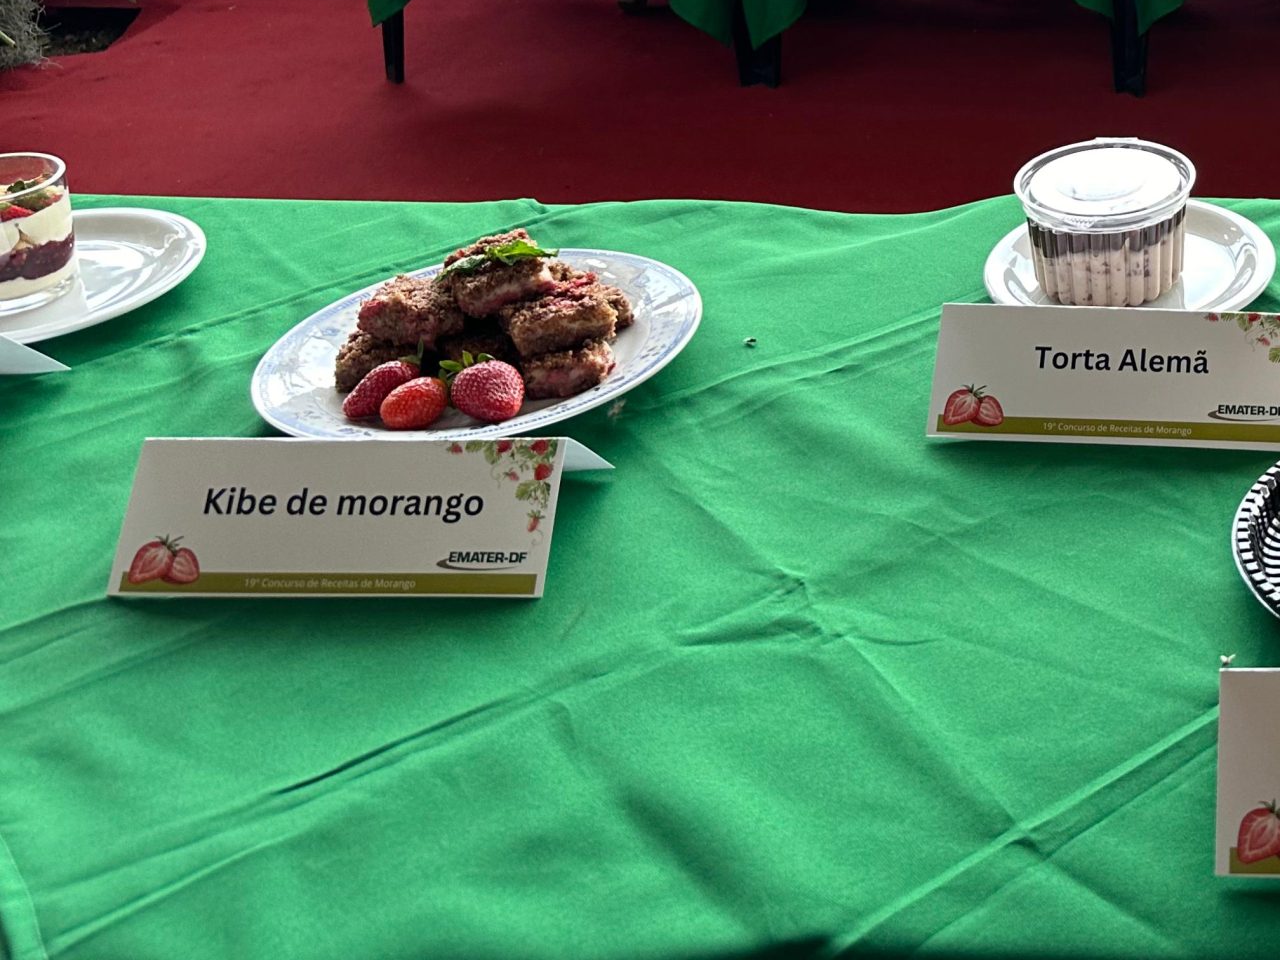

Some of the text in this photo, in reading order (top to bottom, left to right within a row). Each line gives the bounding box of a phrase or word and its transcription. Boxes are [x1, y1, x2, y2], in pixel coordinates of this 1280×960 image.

[1035, 346, 1209, 374] Torta Alemã
[1058, 422, 1096, 432] Concurso
[1097, 423, 1108, 432] de
[1109, 424, 1143, 434] Receitas
[1144, 425, 1155, 434] de
[1156, 425, 1192, 437] Morango
[203, 487, 484, 524] Kibe de morango
[448, 551, 528, 564] EMATER-DF
[261, 578, 305, 589] Concurso
[306, 577, 319, 589] de
[320, 578, 358, 589] Receitas
[360, 578, 373, 589] de
[375, 578, 416, 591] Morango
